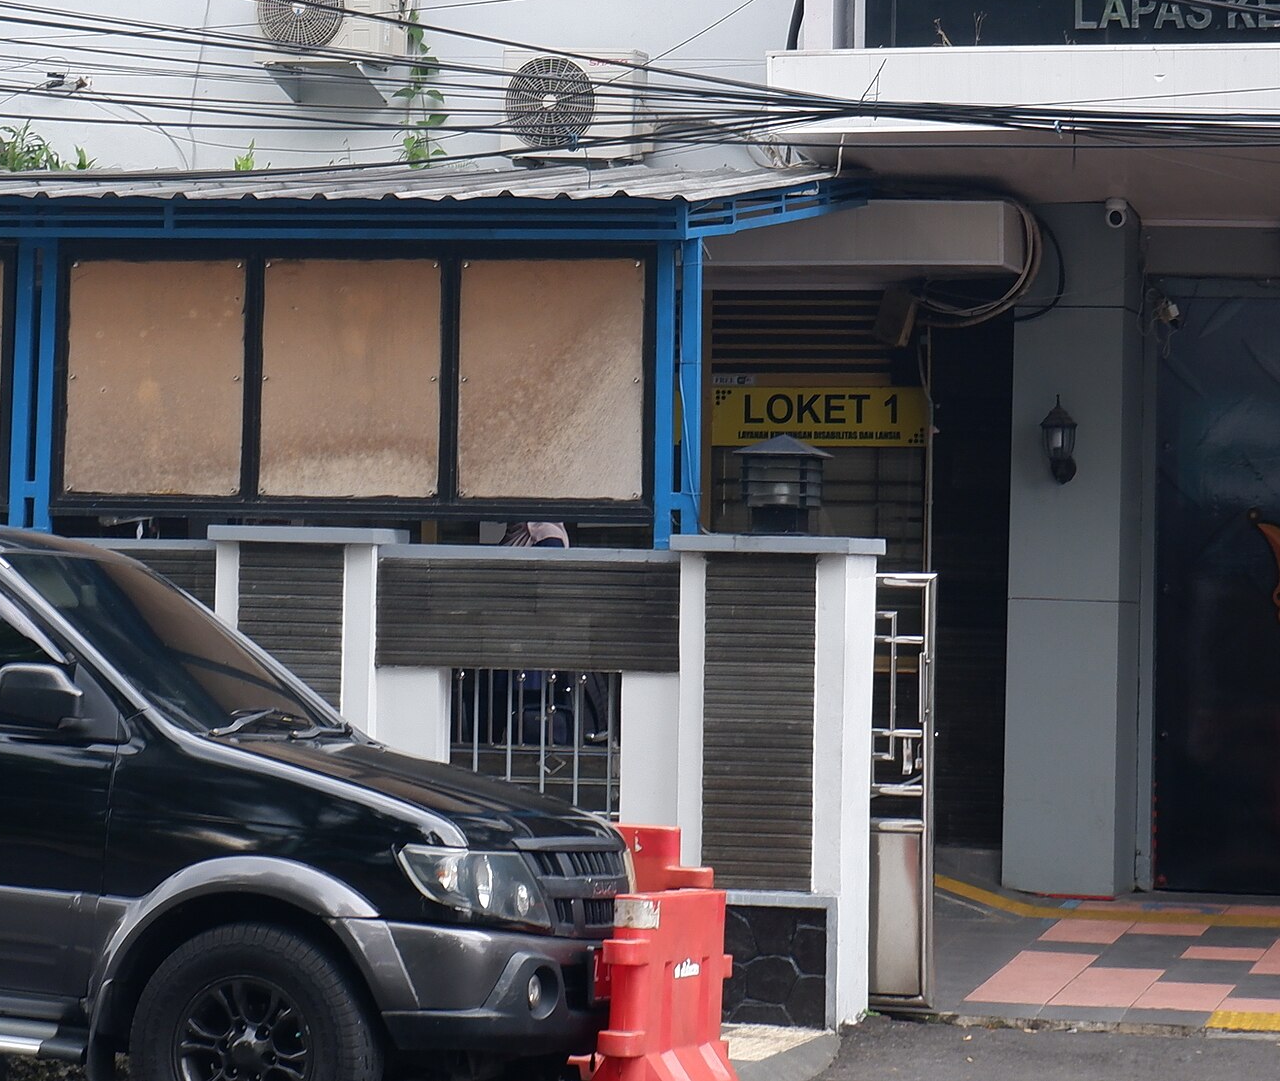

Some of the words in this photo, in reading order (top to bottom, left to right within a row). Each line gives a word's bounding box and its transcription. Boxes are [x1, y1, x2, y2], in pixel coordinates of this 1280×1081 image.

[743, 394, 870, 424] LOKET
[883, 393, 898, 424] 1
[738, 431, 768, 440] LAYANAN
[859, 431, 874, 440] DAN
